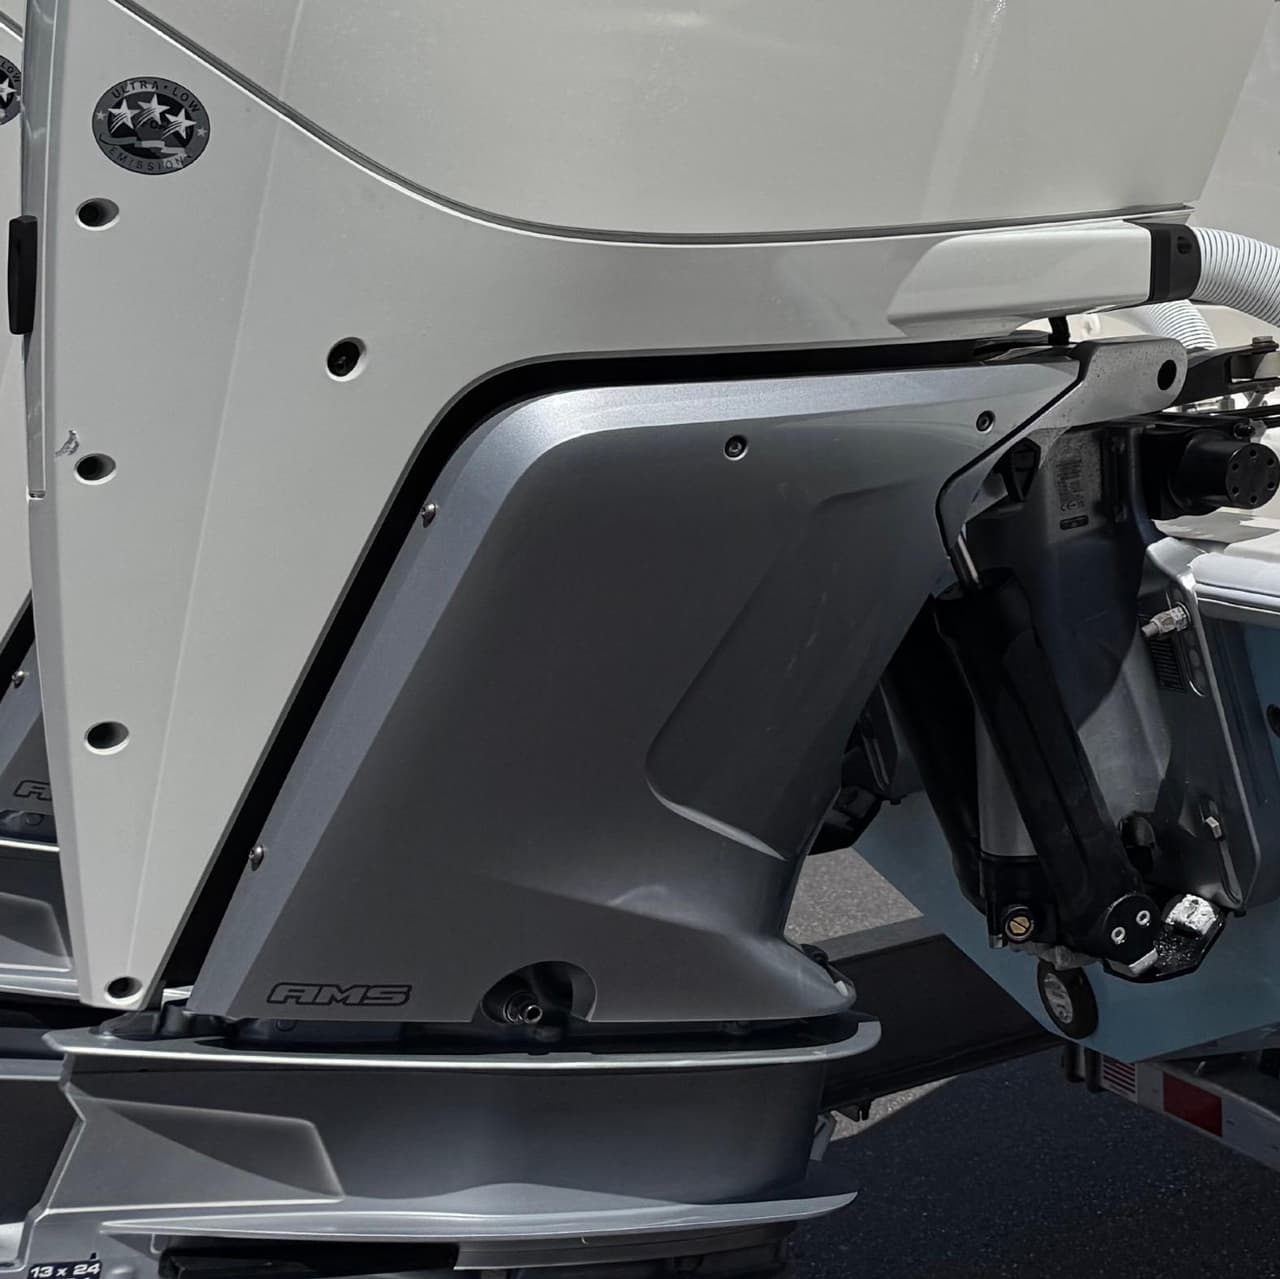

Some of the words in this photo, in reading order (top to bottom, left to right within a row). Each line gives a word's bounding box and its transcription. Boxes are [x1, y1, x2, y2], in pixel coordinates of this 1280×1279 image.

[111, 79, 160, 99] ULTRA
[171, 86, 200, 113] LOW
[266, 982, 411, 1006] AMS
[30, 1266, 54, 1279] 13
[73, 1262, 101, 1277] 24
